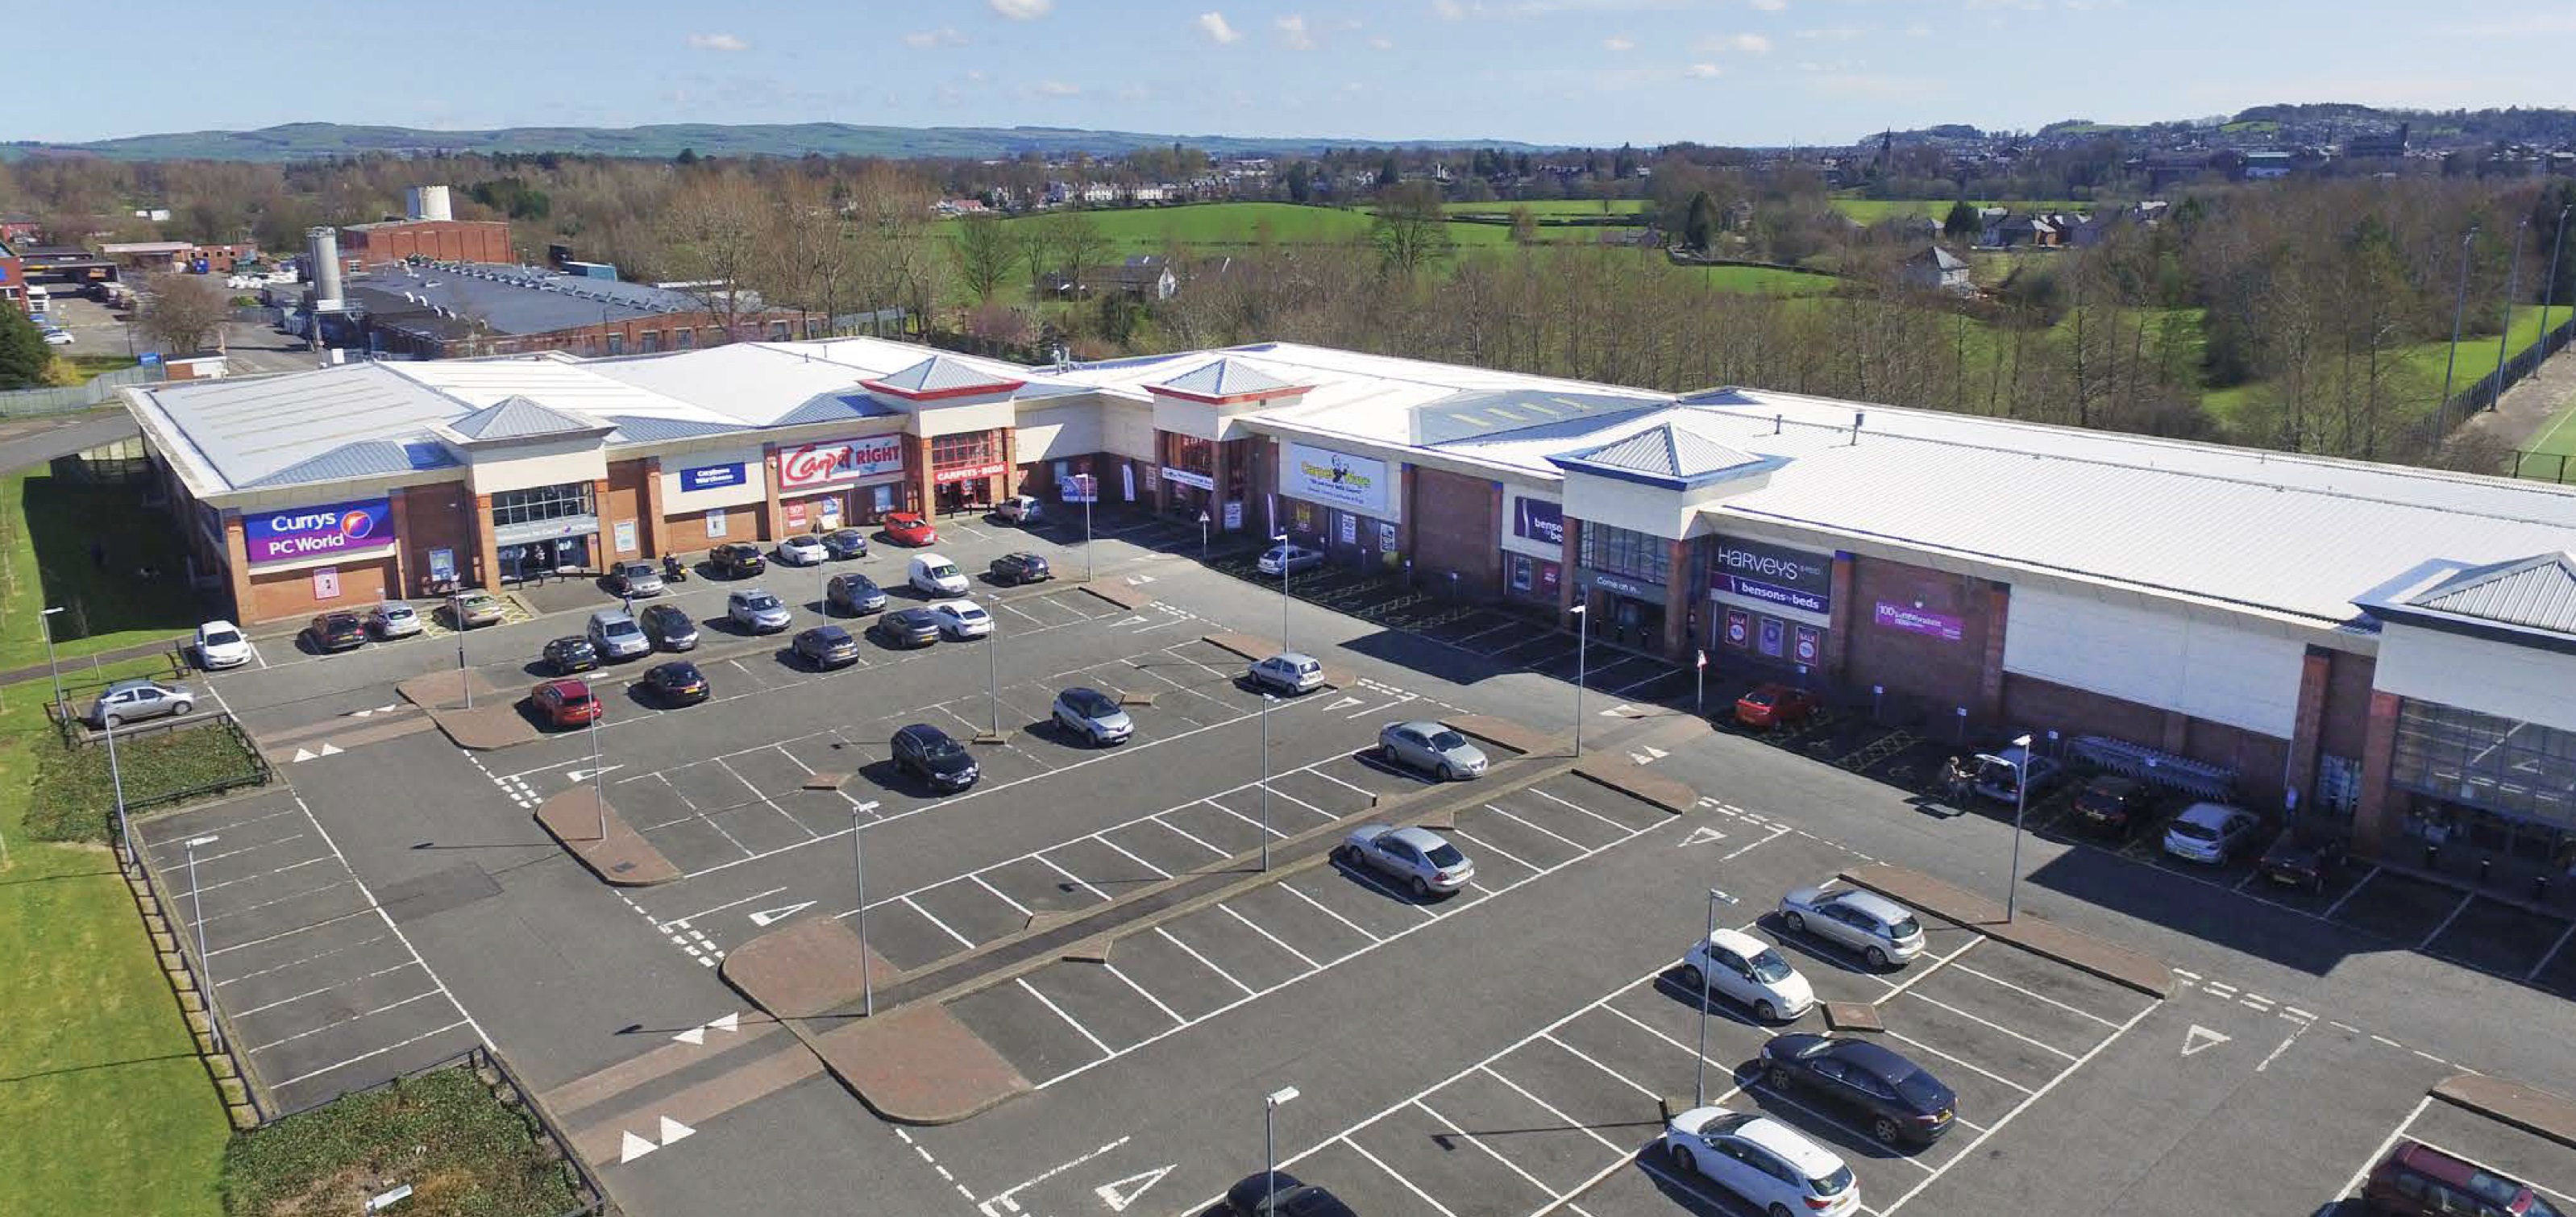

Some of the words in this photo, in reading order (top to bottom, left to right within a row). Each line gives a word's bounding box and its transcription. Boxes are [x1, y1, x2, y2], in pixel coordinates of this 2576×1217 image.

[786, 442, 854, 482] Carpet
[272, 513, 336, 531] Currys
[269, 541, 295, 555] PC
[295, 532, 345, 551] World
[1597, 576, 1618, 589] Come
[1618, 583, 1628, 592] on
[1742, 582, 1786, 600] bensons
[1793, 594, 1819, 609] beds
